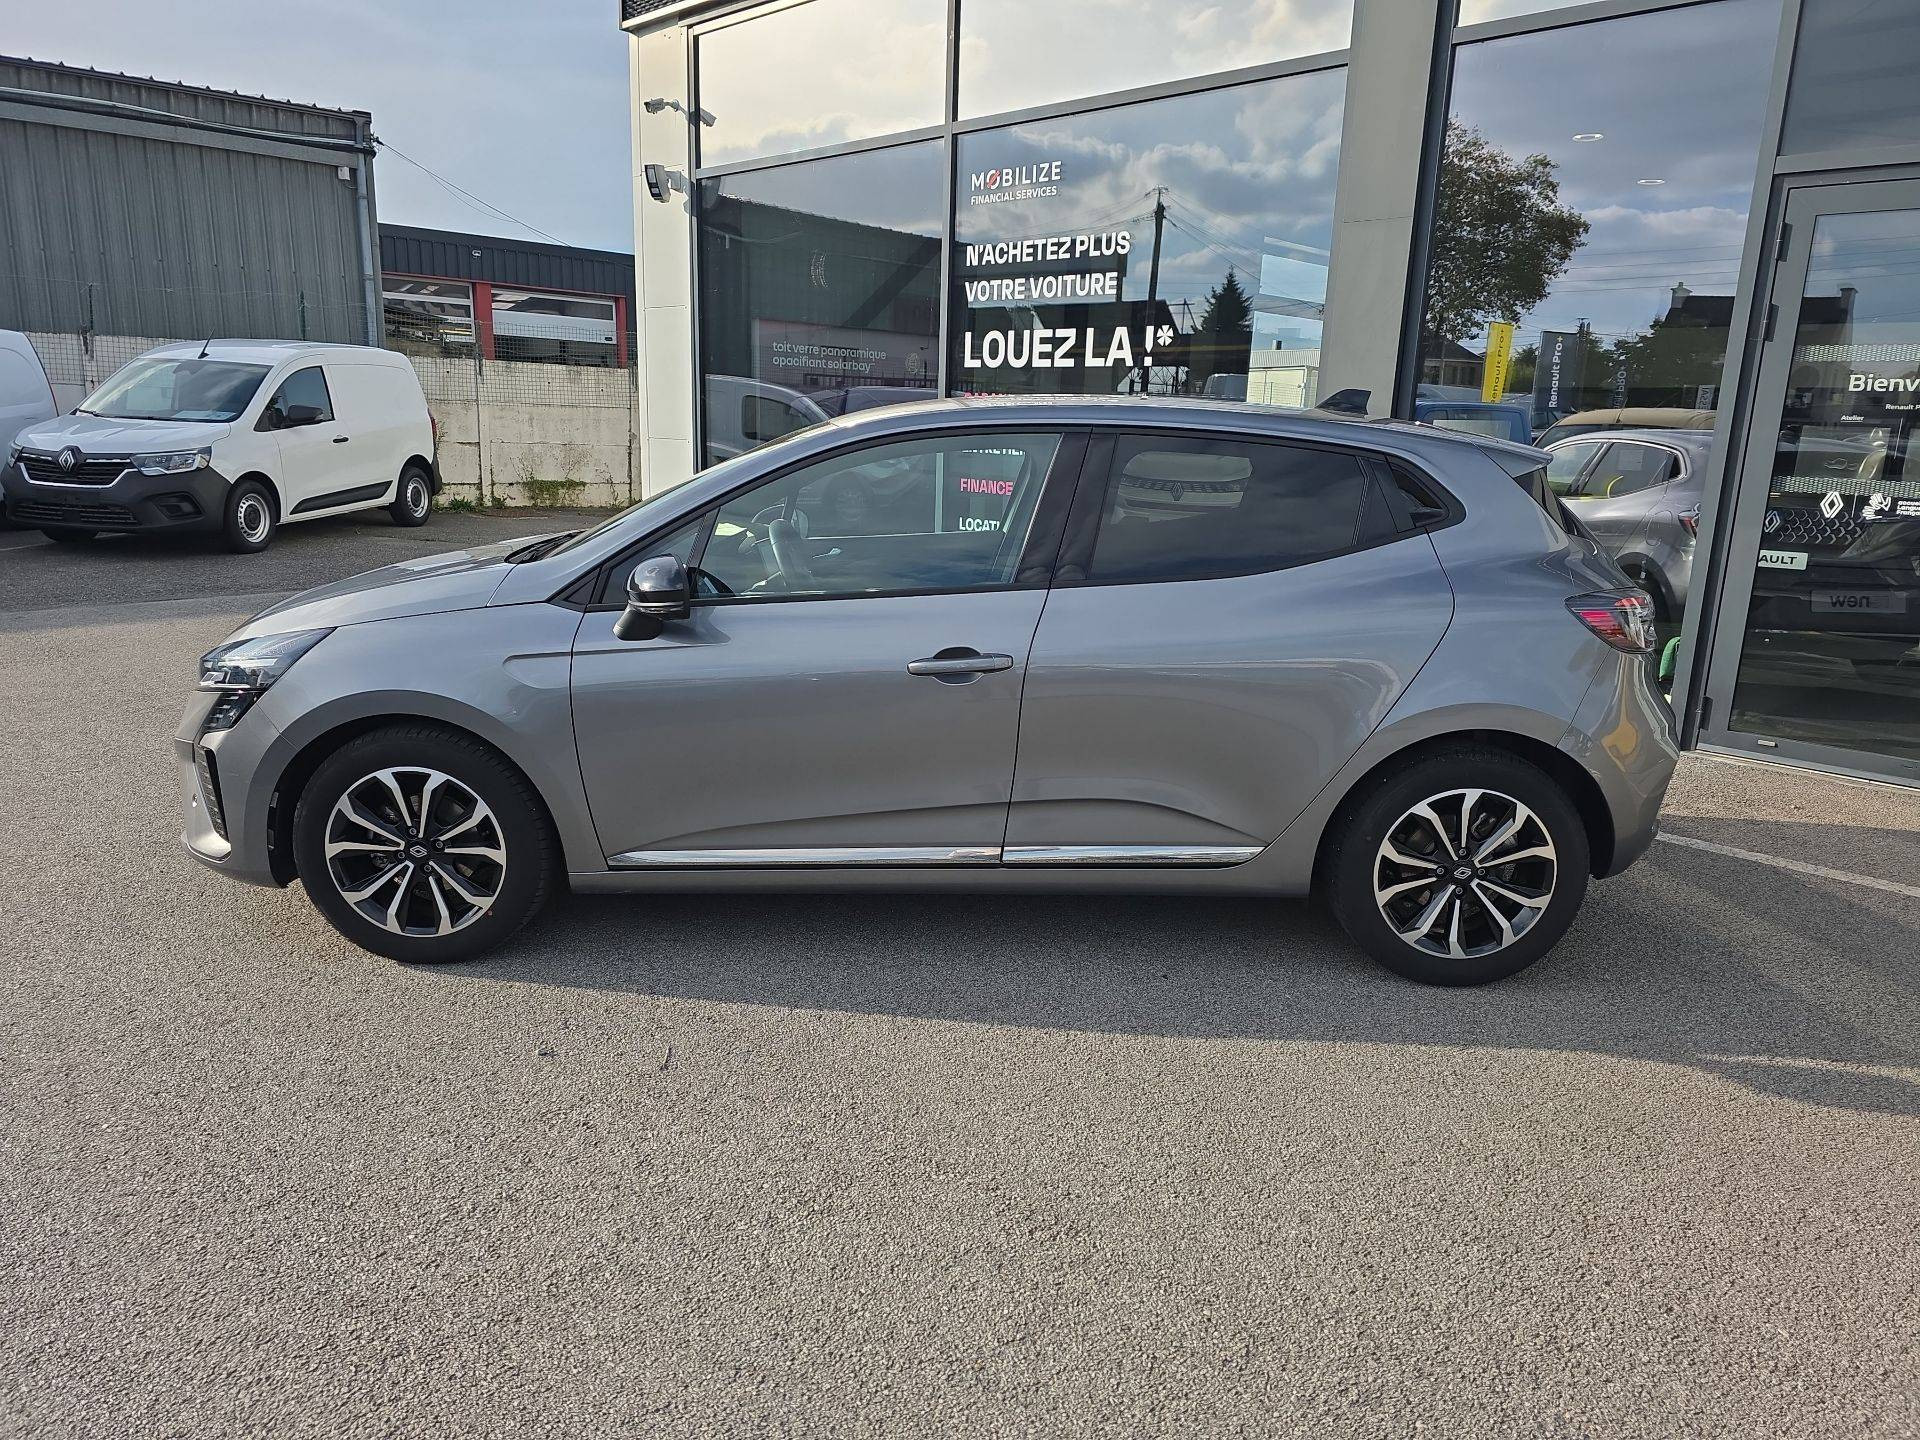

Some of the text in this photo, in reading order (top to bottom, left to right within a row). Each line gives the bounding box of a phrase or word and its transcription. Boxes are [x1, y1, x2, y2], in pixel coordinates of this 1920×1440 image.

[971, 161, 1062, 191] MOBILIZE
[971, 186, 1057, 206] FINANCIAL SERVICES
[966, 230, 1131, 267] N'ACHETEZ PLUS
[965, 271, 1118, 303] VOTRE VOITURE
[772, 341, 887, 362] toit verre panoramique
[772, 355, 827, 369] opacifiant
[963, 327, 1077, 368] LOUEZ
[1085, 326, 1133, 367] LA
[1548, 364, 1560, 408] Renault
[960, 478, 1013, 495] FINANCE
